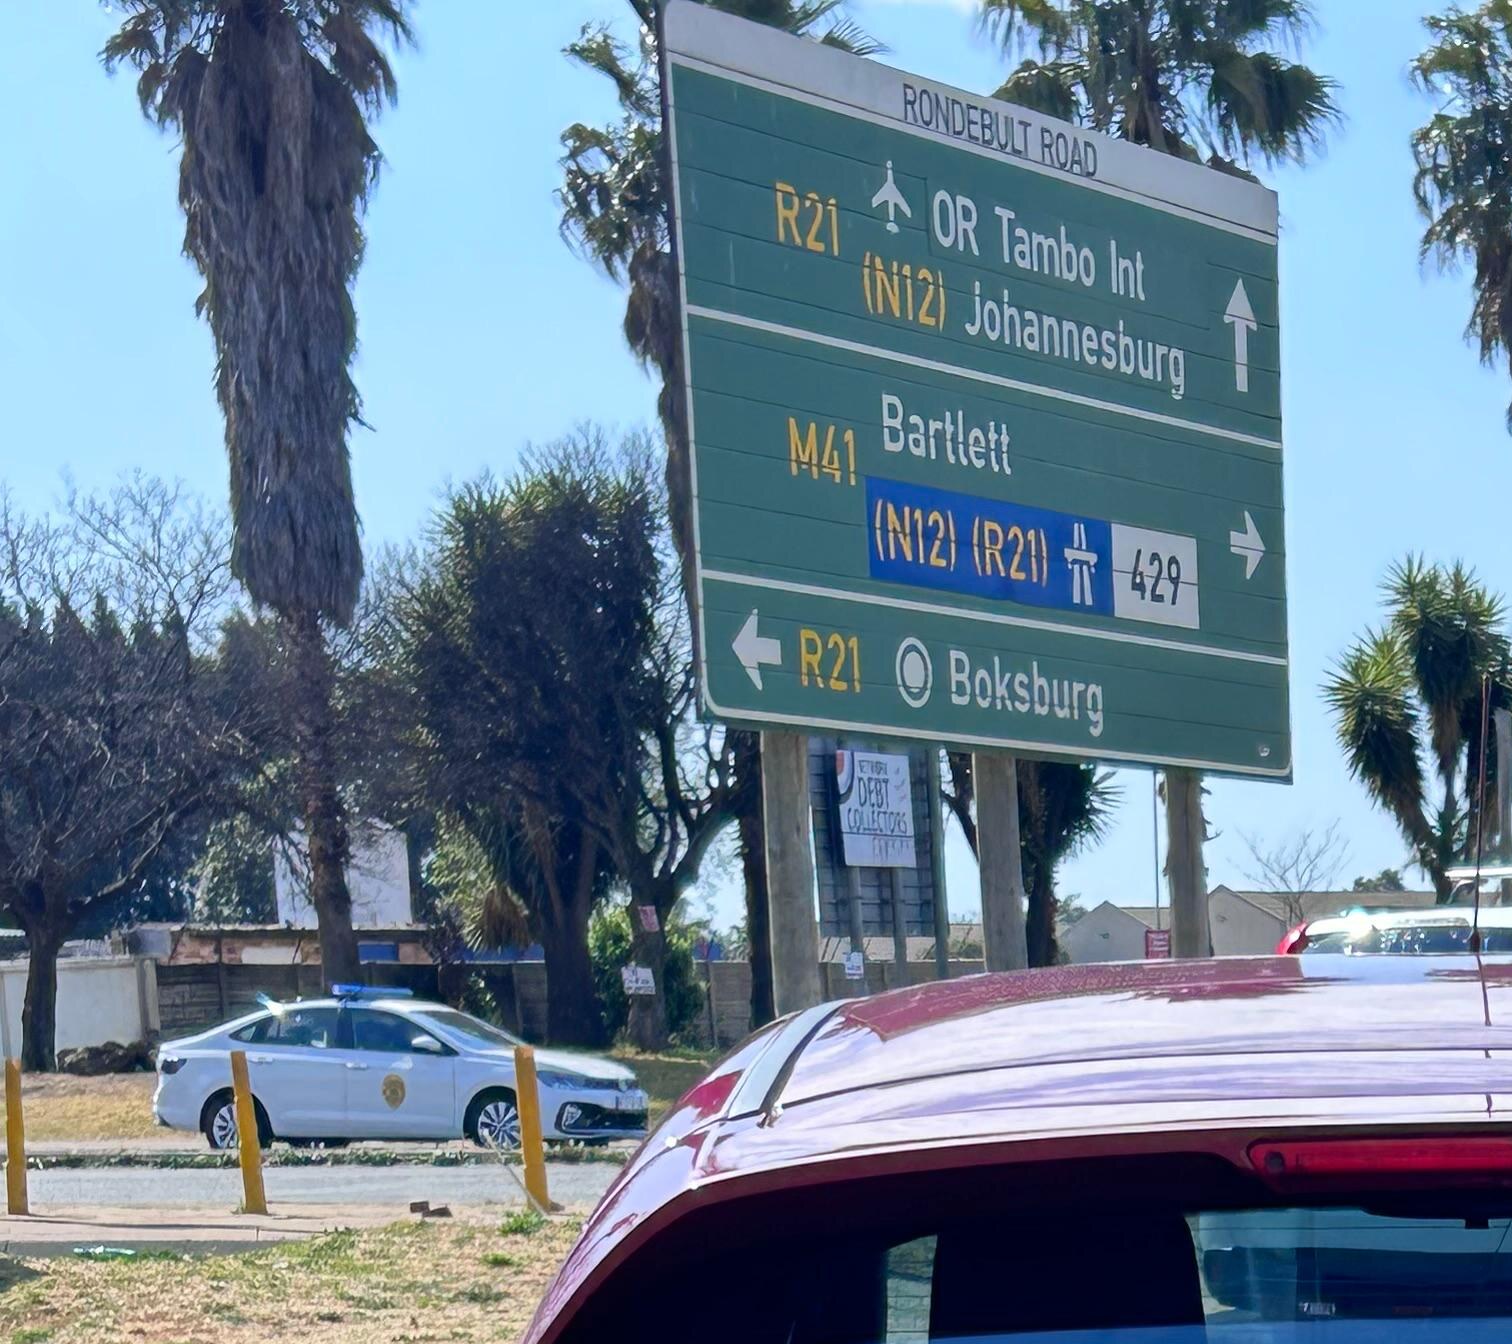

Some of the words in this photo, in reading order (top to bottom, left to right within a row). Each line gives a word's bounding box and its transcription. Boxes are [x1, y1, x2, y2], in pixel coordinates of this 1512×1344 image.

[902, 82, 1032, 159] RONDEBULT
[1042, 128, 1098, 179] ROAD
[775, 180, 842, 257] R21
[932, 188, 980, 257] OR
[994, 204, 1096, 288] Tambo
[1110, 239, 1146, 302] Int
[862, 251, 946, 332] (N12)
[964, 281, 1187, 400] Johannesburg
[786, 415, 859, 488] M41
[881, 391, 1013, 475] Bartlett
[874, 498, 957, 573] (N12)
[972, 515, 1050, 588] (R21)
[1129, 547, 1182, 607] 429
[799, 627, 863, 694] R21
[948, 649, 1105, 738] Boksburg
[857, 776, 889, 810] DEBT
